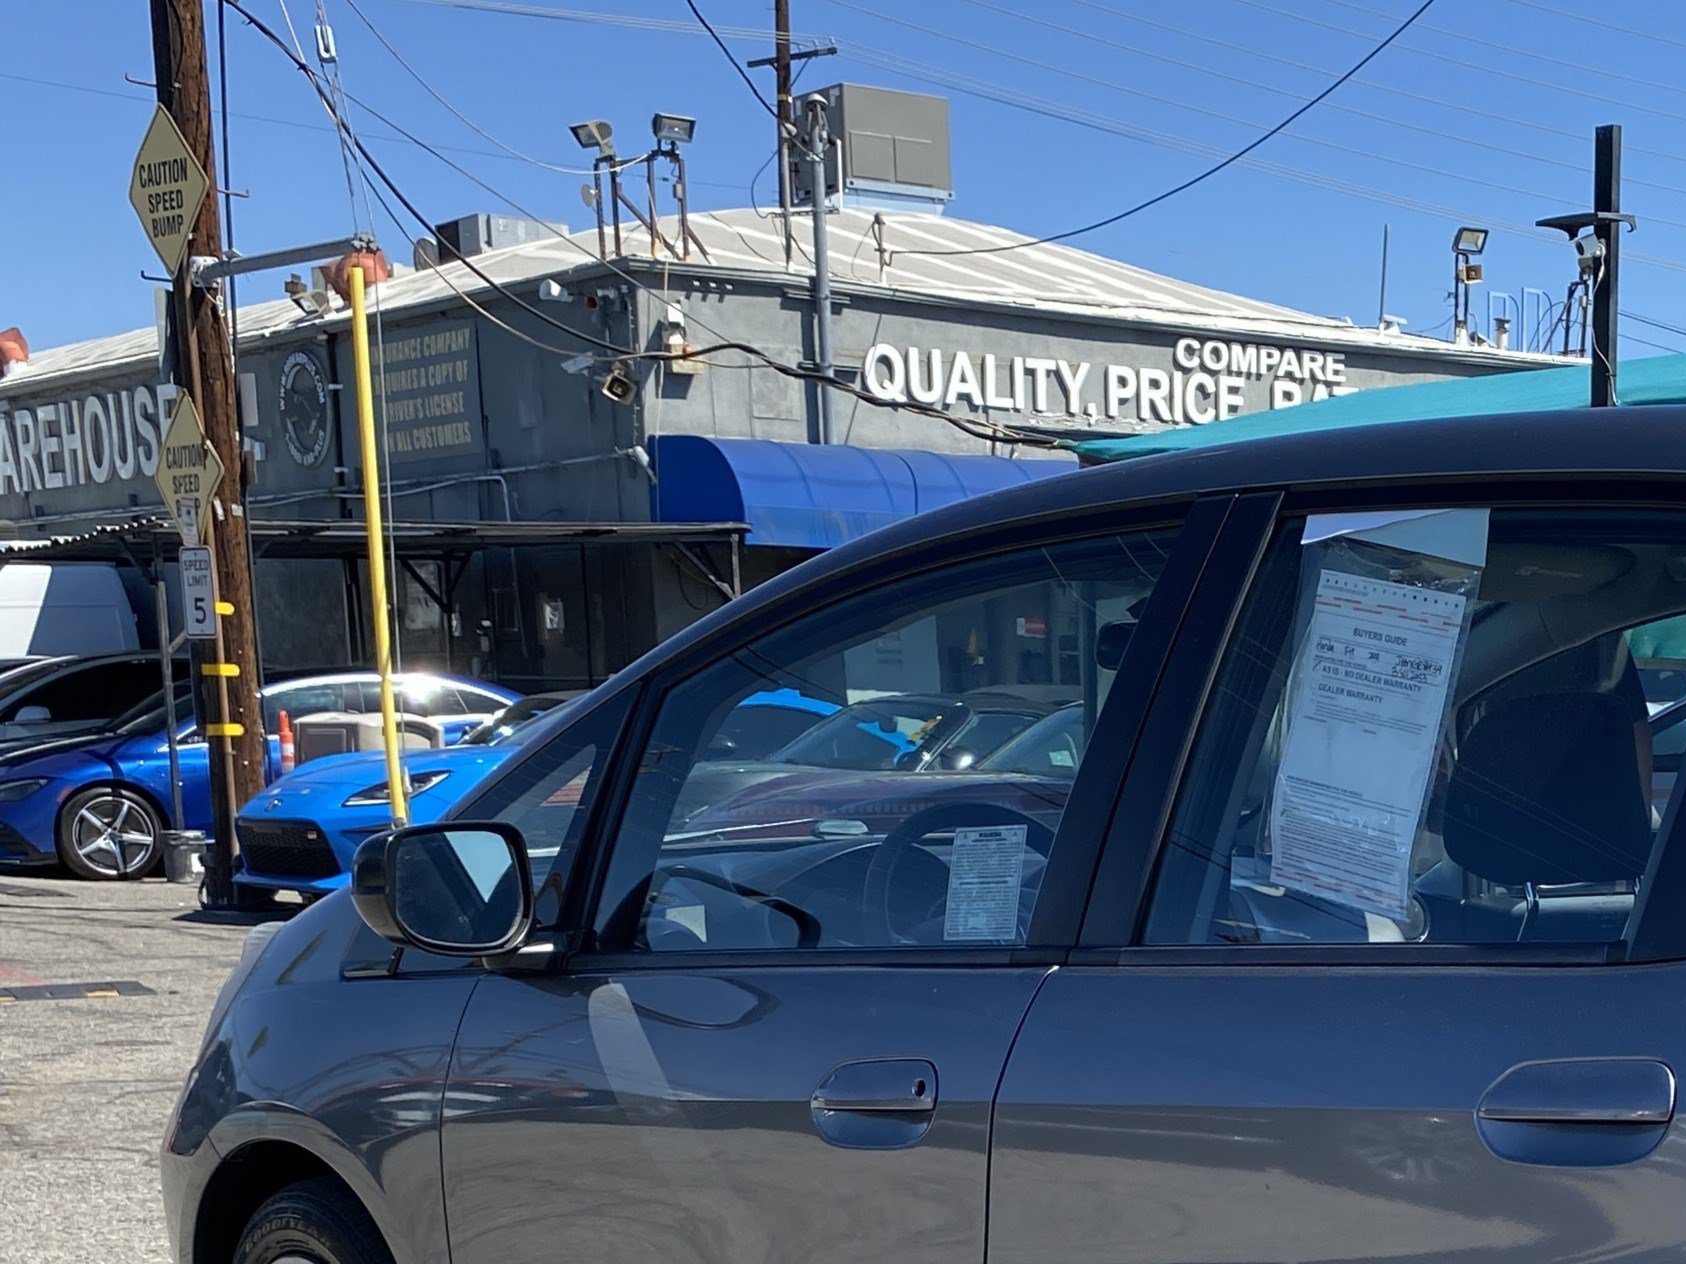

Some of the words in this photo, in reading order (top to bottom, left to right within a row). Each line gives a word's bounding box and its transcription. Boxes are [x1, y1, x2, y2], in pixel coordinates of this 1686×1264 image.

[139, 157, 188, 189] CAUTION
[148, 189, 184, 214] SPEED
[152, 214, 184, 238] BUMP
[423, 328, 470, 357] COMPANY
[420, 367, 427, 387] A
[428, 362, 454, 387] COPY
[455, 360, 468, 382] OF
[1176, 338, 1347, 382] COMPARE
[864, 343, 1097, 425] QUALITY,
[1108, 365, 1245, 425] PRICE
[425, 391, 464, 418] LICENSE
[396, 430, 413, 452] ALL
[413, 421, 471, 450] CUSTOMERS
[165, 443, 204, 470] CAUTION
[172, 473, 200, 494] SPEED
[183, 559, 209, 572] SPEED
[187, 575, 208, 587] LIMIT
[194, 597, 207, 624] 5
[1353, 628, 1384, 642] BUYERS
[1384, 634, 1408, 646] GUIDE
[1318, 682, 1345, 696] DEALER
[1345, 688, 1383, 704] WARRANTY
[1355, 672, 1382, 685] DEALER
[1383, 678, 1422, 692] WARRANTY
